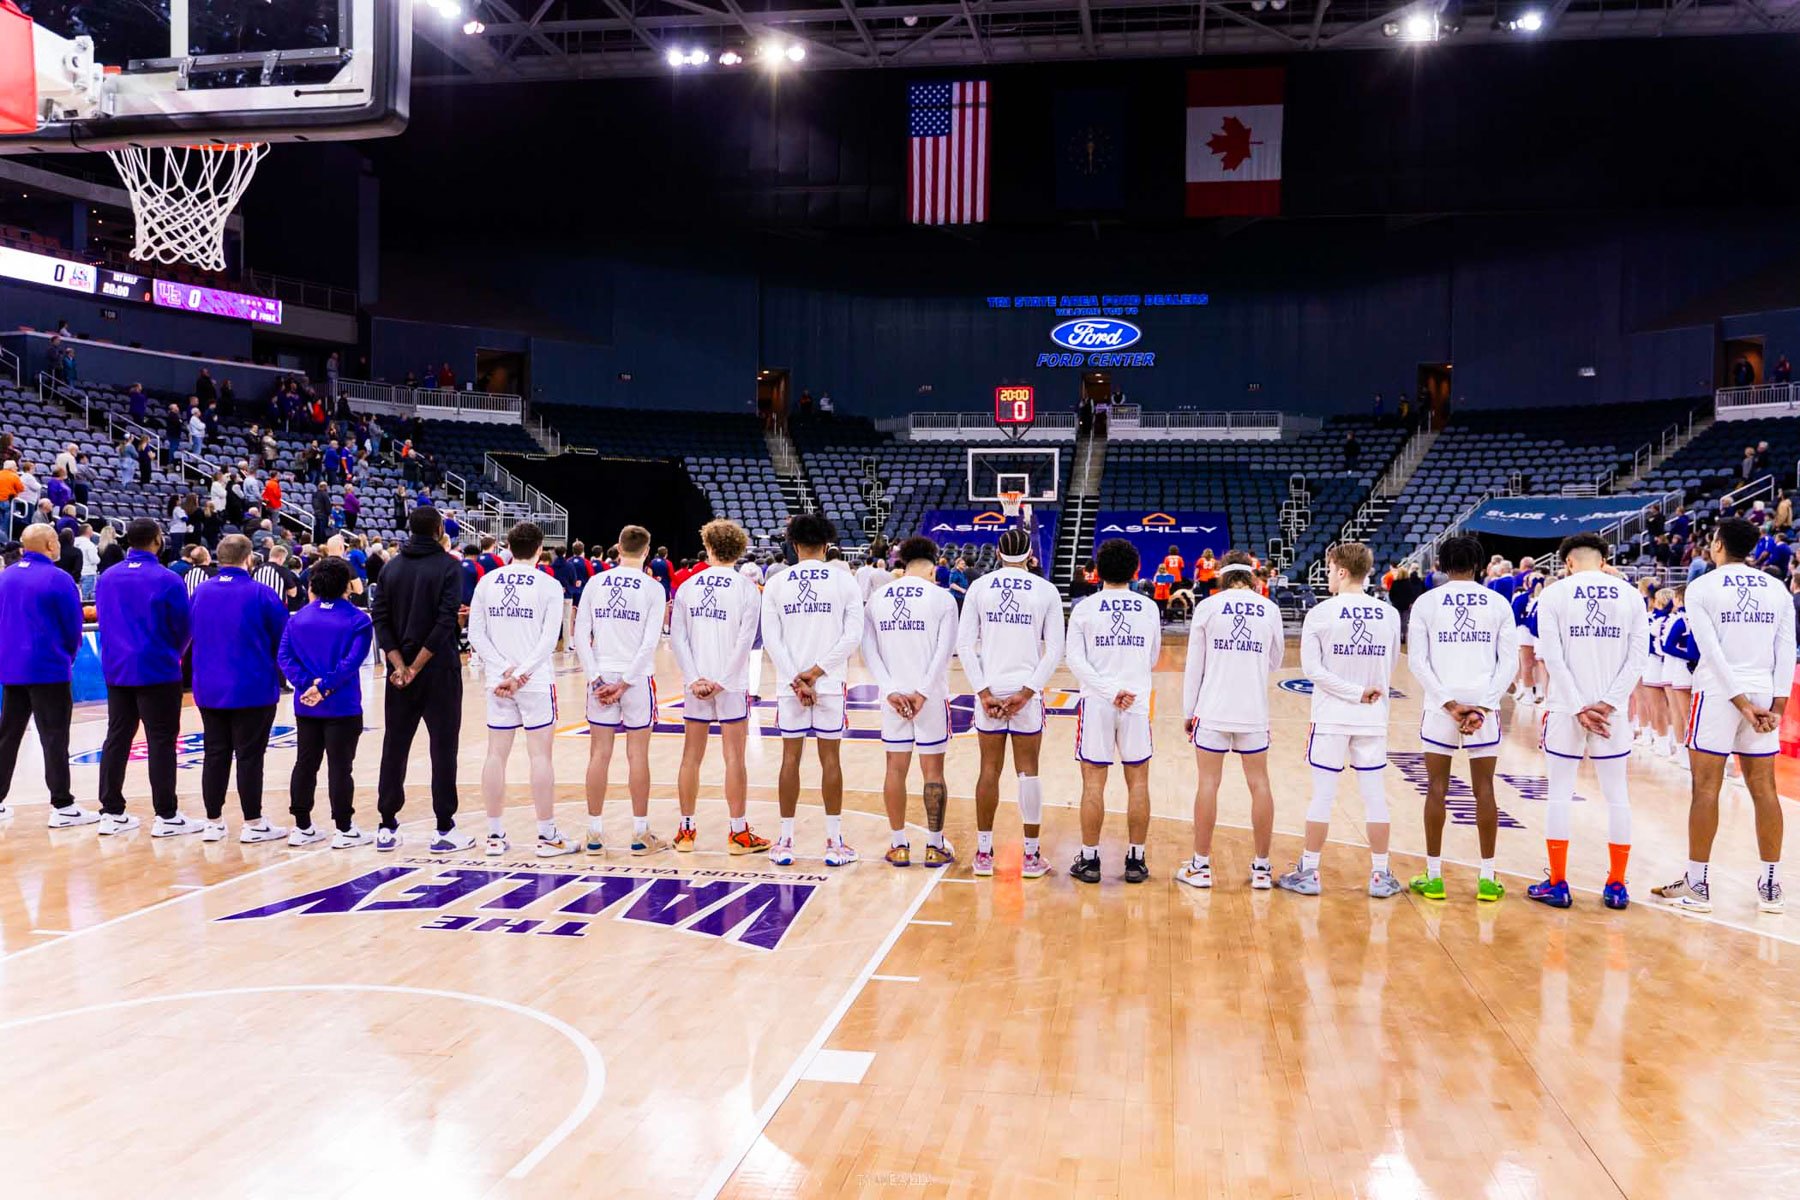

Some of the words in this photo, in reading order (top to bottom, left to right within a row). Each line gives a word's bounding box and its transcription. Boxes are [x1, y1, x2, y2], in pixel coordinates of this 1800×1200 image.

[54, 264, 64, 282] 0
[188, 289, 201, 308] 0
[1014, 296, 1056, 307] STATE
[1060, 295, 1098, 306] AREA
[1144, 294, 1208, 305] DEALERS
[1068, 323, 1124, 345] Ford
[1036, 353, 1084, 367] FORD
[1088, 352, 1155, 366] CENTER
[1000, 390, 1029, 401] 20:00
[1014, 401, 1026, 420] 0
[1101, 524, 1218, 534] ASHLEY
[494, 573, 535, 586] ACES
[788, 569, 830, 581] ACES
[602, 576, 641, 590] ACES
[695, 576, 732, 588] ACES
[990, 578, 1032, 590] ACES
[1723, 576, 1768, 587] ACES
[884, 586, 924, 597] ACES
[1574, 586, 1618, 599] ACES
[1100, 600, 1142, 612] ACES
[1442, 594, 1488, 606] ACES
[507, 607, 534, 618] CANCER
[612, 608, 640, 621] CANCER
[784, 604, 800, 614] BEAT
[804, 603, 831, 612] CANCER
[1222, 602, 1265, 617] ACES
[1340, 607, 1384, 620] ACES
[1721, 612, 1741, 623] BEAT
[898, 620, 924, 631] CANCER
[1096, 636, 1114, 646] BEAT
[1118, 635, 1144, 647] CANCER
[1438, 632, 1458, 642] BEAT
[1461, 632, 1490, 642] CANCER
[1214, 639, 1234, 650] BEAT
[1334, 644, 1354, 655] BEAT
[1357, 644, 1386, 656] CANCER
[580, 865, 679, 876] VALLEY
[693, 870, 828, 881] MISSOURI
[213, 867, 816, 950] VALLEY
[420, 915, 590, 937] THE
